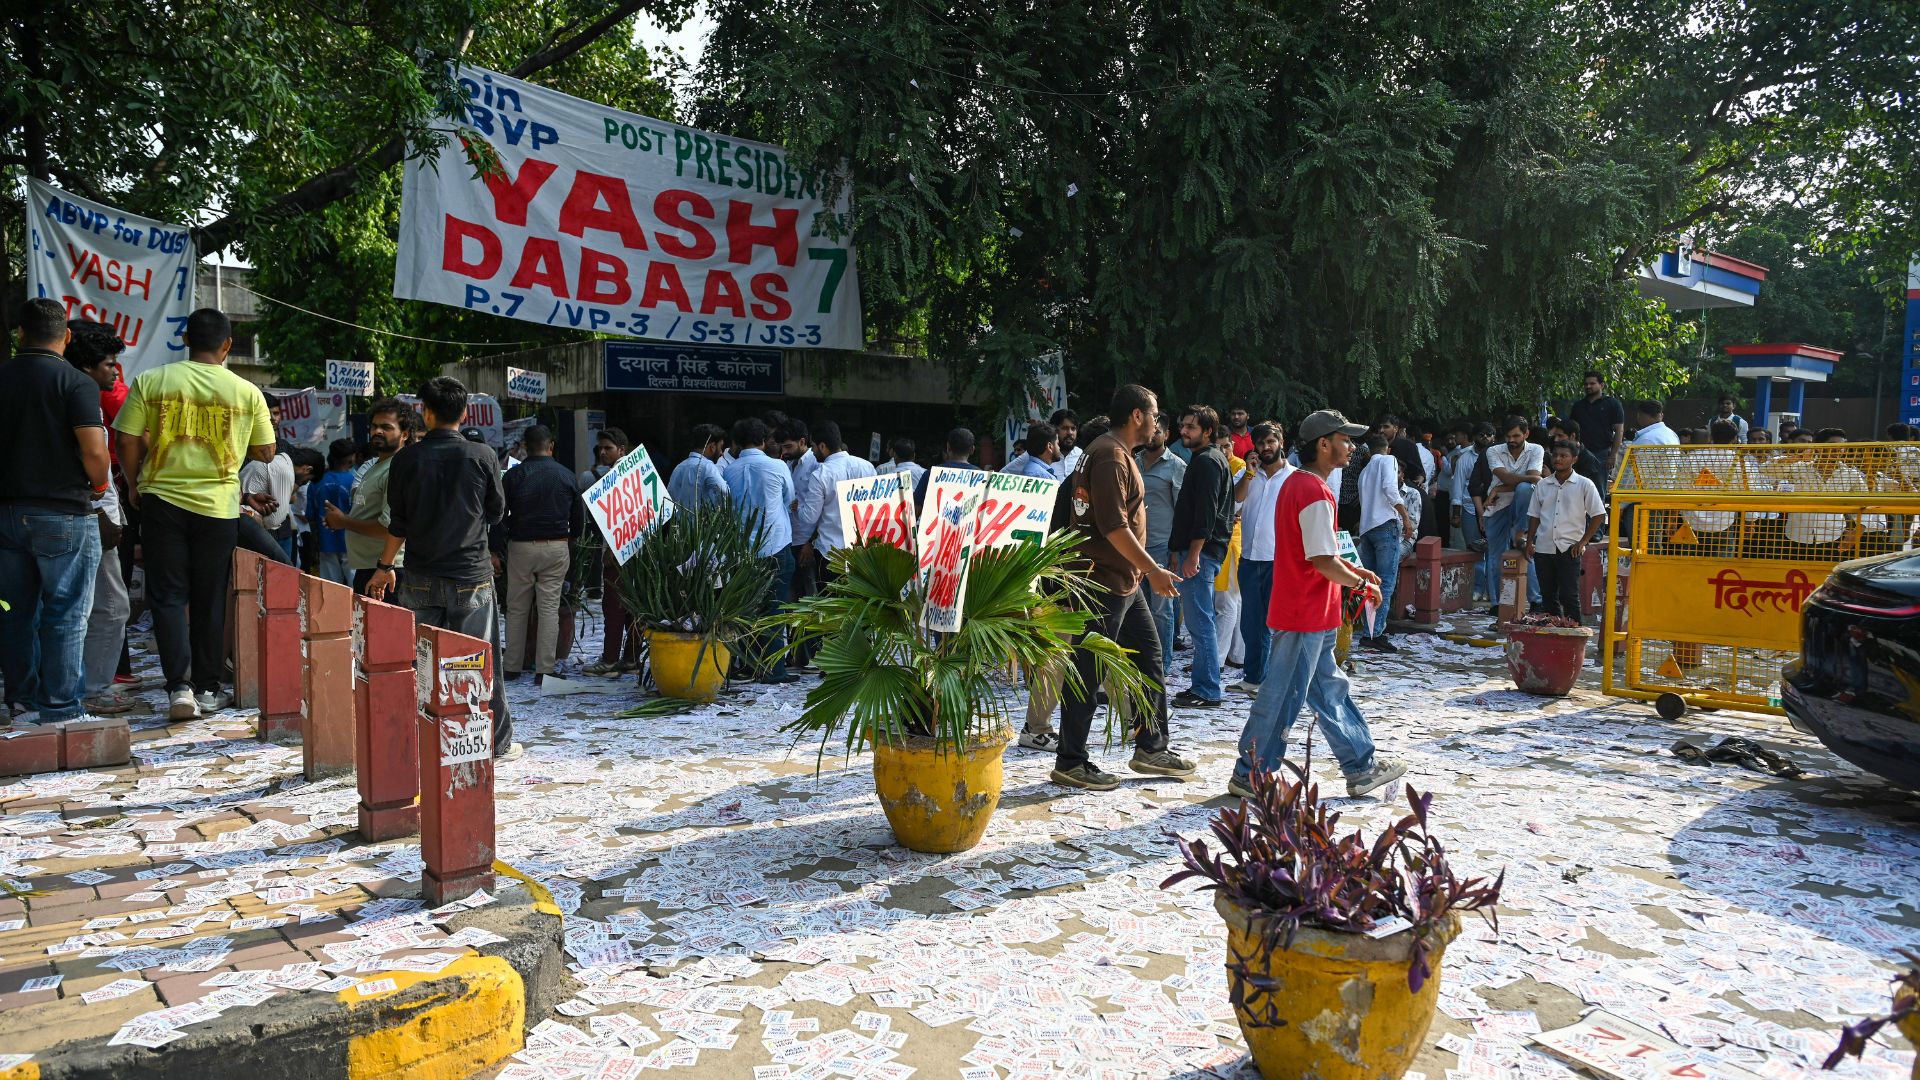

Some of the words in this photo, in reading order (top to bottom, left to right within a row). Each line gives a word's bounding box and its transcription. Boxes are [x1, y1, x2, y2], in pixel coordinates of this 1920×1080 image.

[444, 63, 523, 112] oin
[604, 117, 668, 156] POST
[45, 195, 109, 235] ABVP
[113, 217, 144, 246] for
[459, 134, 800, 268] YASH
[66, 242, 153, 301] YASH
[442, 213, 793, 323] DABAAS
[808, 247, 848, 314] 7
[329, 362, 338, 385] 3
[617, 356, 670, 373] दयाल
[675, 354, 711, 375] सिंह
[716, 356, 773, 377] कॉलेज
[647, 374, 679, 389] दिल्ली
[596, 468, 644, 531] YASH
[643, 471, 659, 513] 7
[846, 483, 869, 502] Join
[935, 469, 956, 484] Join
[1707, 568, 1815, 618] दिल्ली
